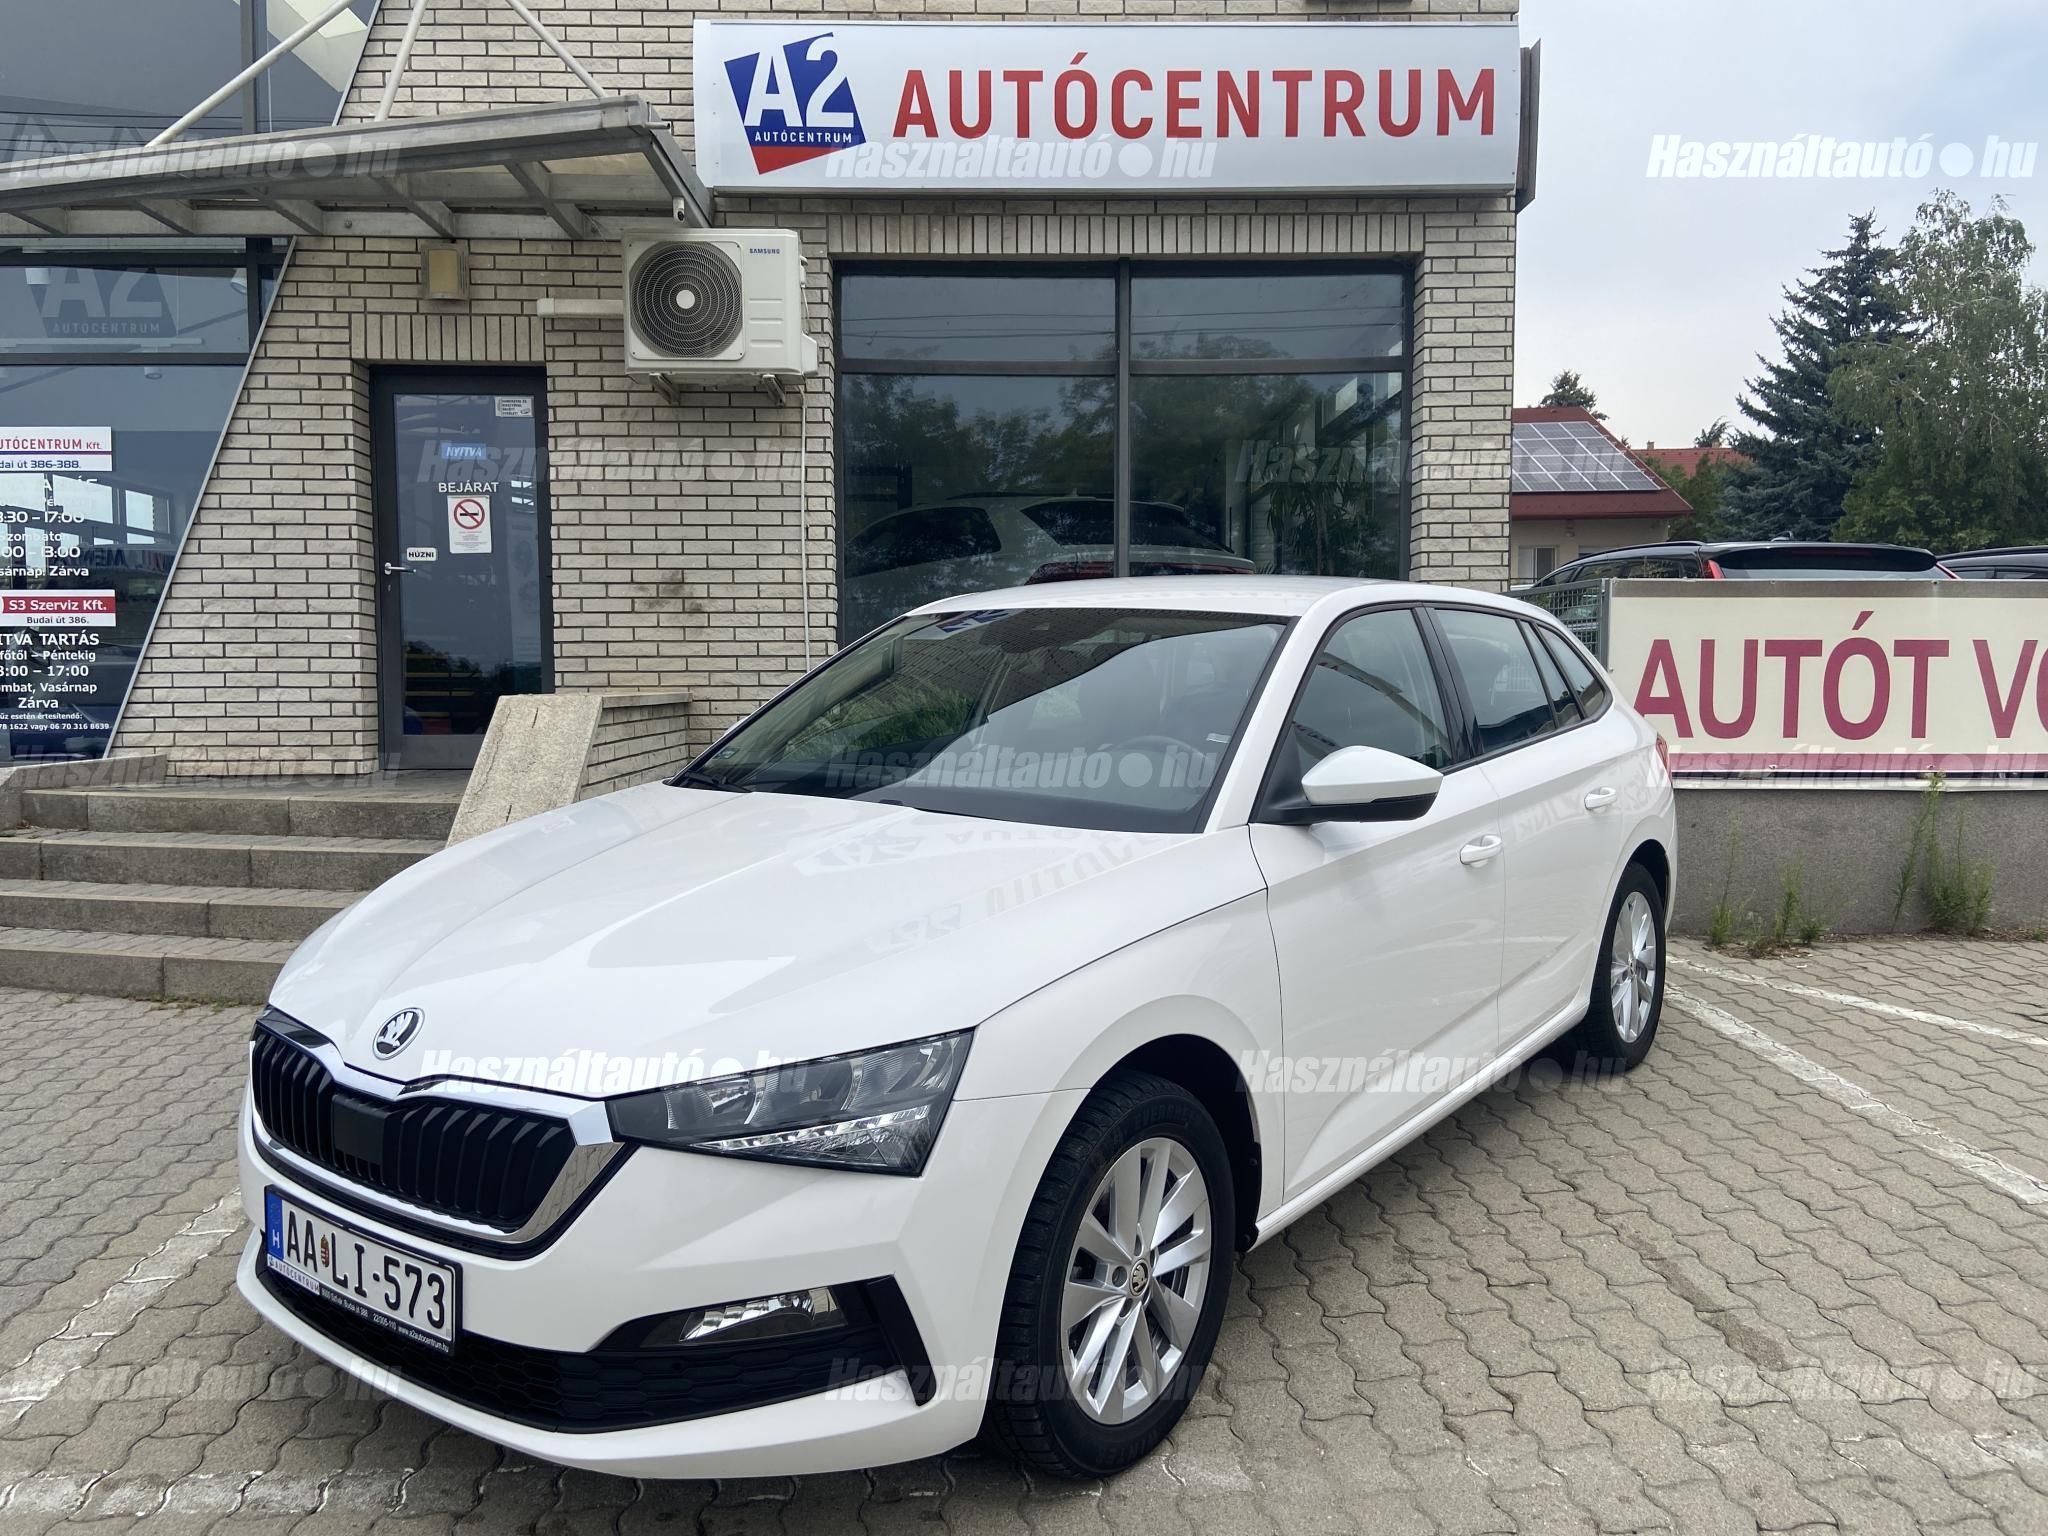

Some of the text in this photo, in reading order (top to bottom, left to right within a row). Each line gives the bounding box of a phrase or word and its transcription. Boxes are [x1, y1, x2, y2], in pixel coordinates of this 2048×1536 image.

[743, 36, 854, 127] A2
[892, 51, 1495, 140] AUTÓCENTRUM
[755, 130, 852, 143] AUTÓCENTRUM
[446, 446, 482, 457] NYITVA
[438, 480, 499, 492] BEJÁRAT
[44, 511, 85, 522] 17:00
[49, 564, 89, 576] Zárva
[9, 600, 107, 611] S3 Szerviz Kft.
[26, 615, 90, 624] Budai út 386.
[38, 629, 100, 645] TARTÁS
[43, 650, 96, 662] Péntekig
[47, 665, 89, 676] 17:00
[1634, 611, 2048, 741] AUTÓT V
[40, 681, 97, 693] Vasárnap
[18, 695, 59, 708] Zárva
[273, 1228, 281, 1249] H
